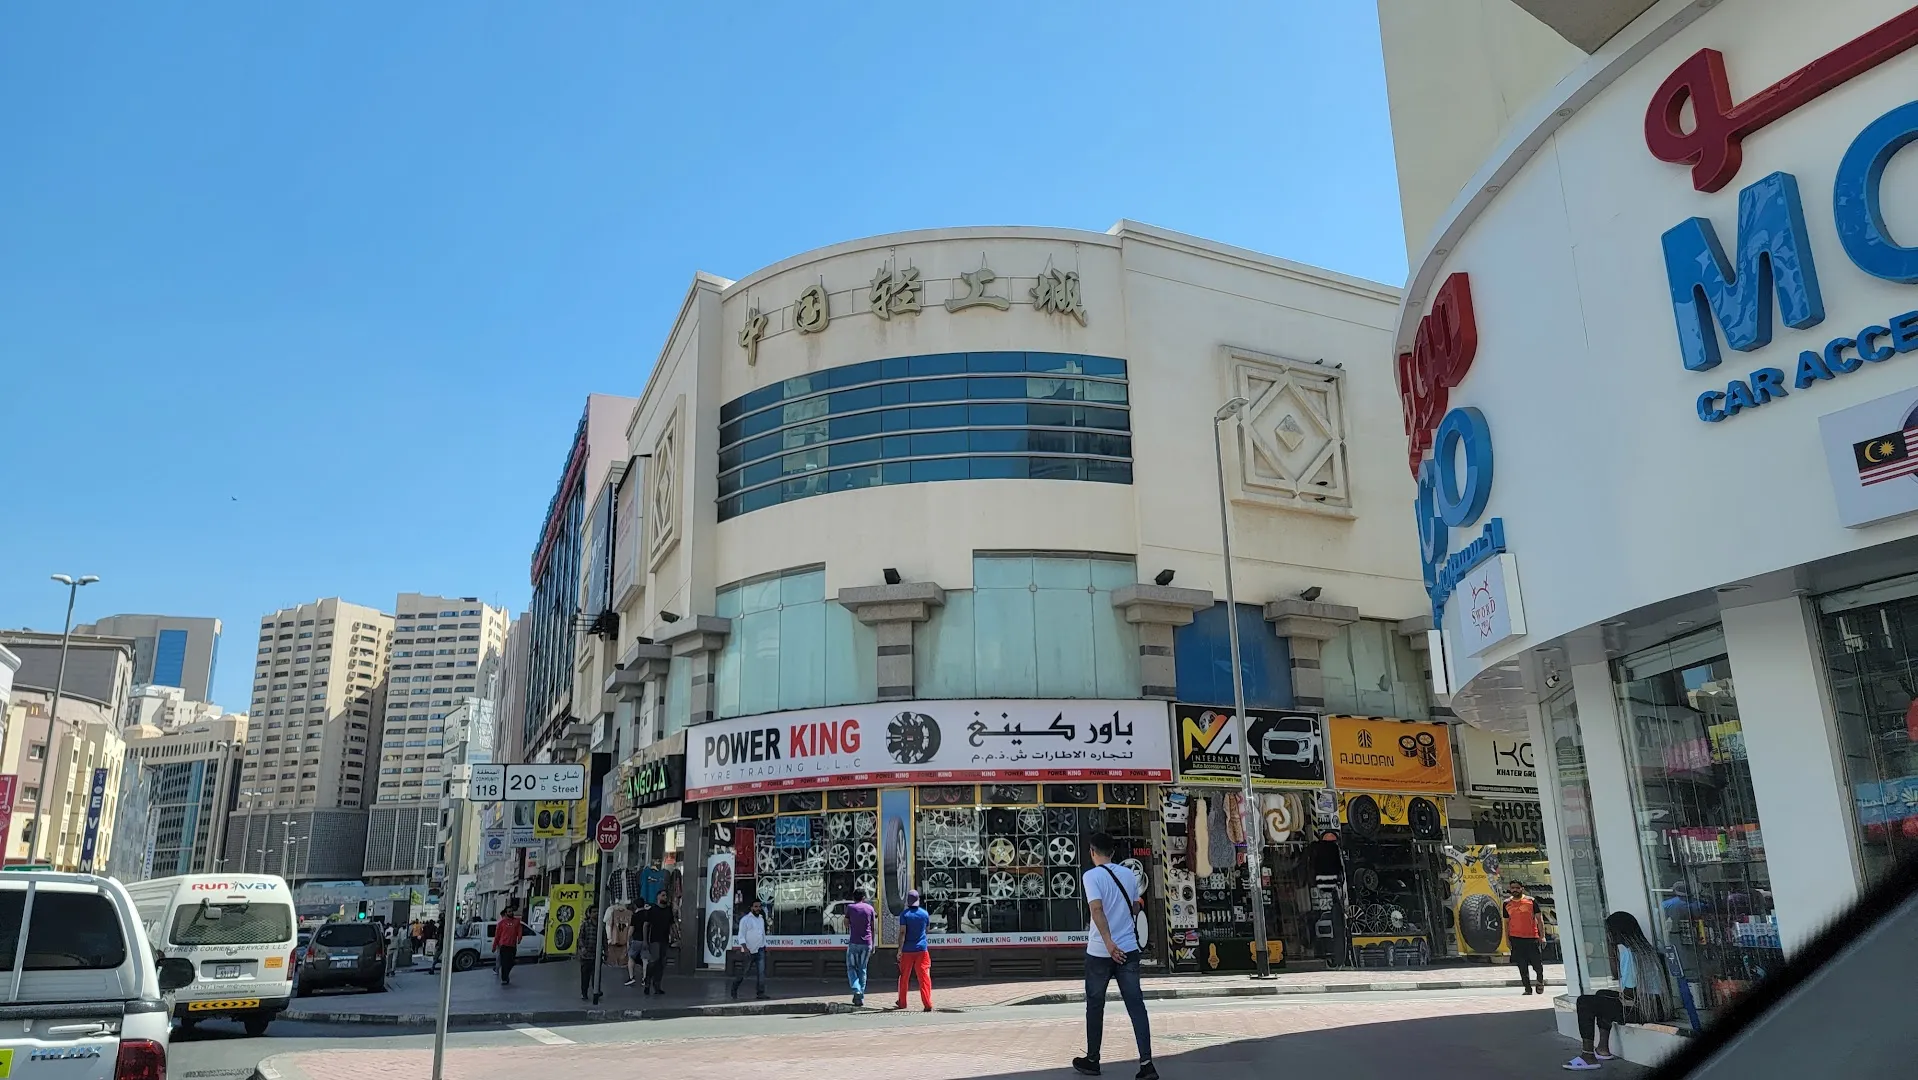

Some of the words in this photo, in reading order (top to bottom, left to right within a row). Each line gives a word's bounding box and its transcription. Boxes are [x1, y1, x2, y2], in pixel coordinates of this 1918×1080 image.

[1697, 366, 1788, 424] CAR
[967, 710, 1076, 747] كينغ
[1084, 710, 1133, 746] باور
[704, 727, 781, 768] POWER
[790, 719, 861, 758] KING
[1032, 751, 1086, 762] الاطارات
[1191, 754, 1261, 765] INTERNATIAL
[1340, 752, 1395, 767] AJOUDAN
[553, 770, 579, 782] شارع
[704, 769, 731, 783] TYRE
[740, 763, 804, 779] TRADING
[1496, 768, 1523, 778] KHATER
[510, 774, 537, 791] 20
[551, 785, 579, 793] Street
[626, 765, 666, 800] ANGOLA
[475, 785, 498, 796] 118
[1492, 801, 1542, 822] SHOES
[601, 818, 618, 832] قف
[600, 834, 618, 844] STOP
[1133, 848, 1151, 856] KING
[560, 890, 580, 900] MRT
[164, 945, 198, 953] EXPRESS
